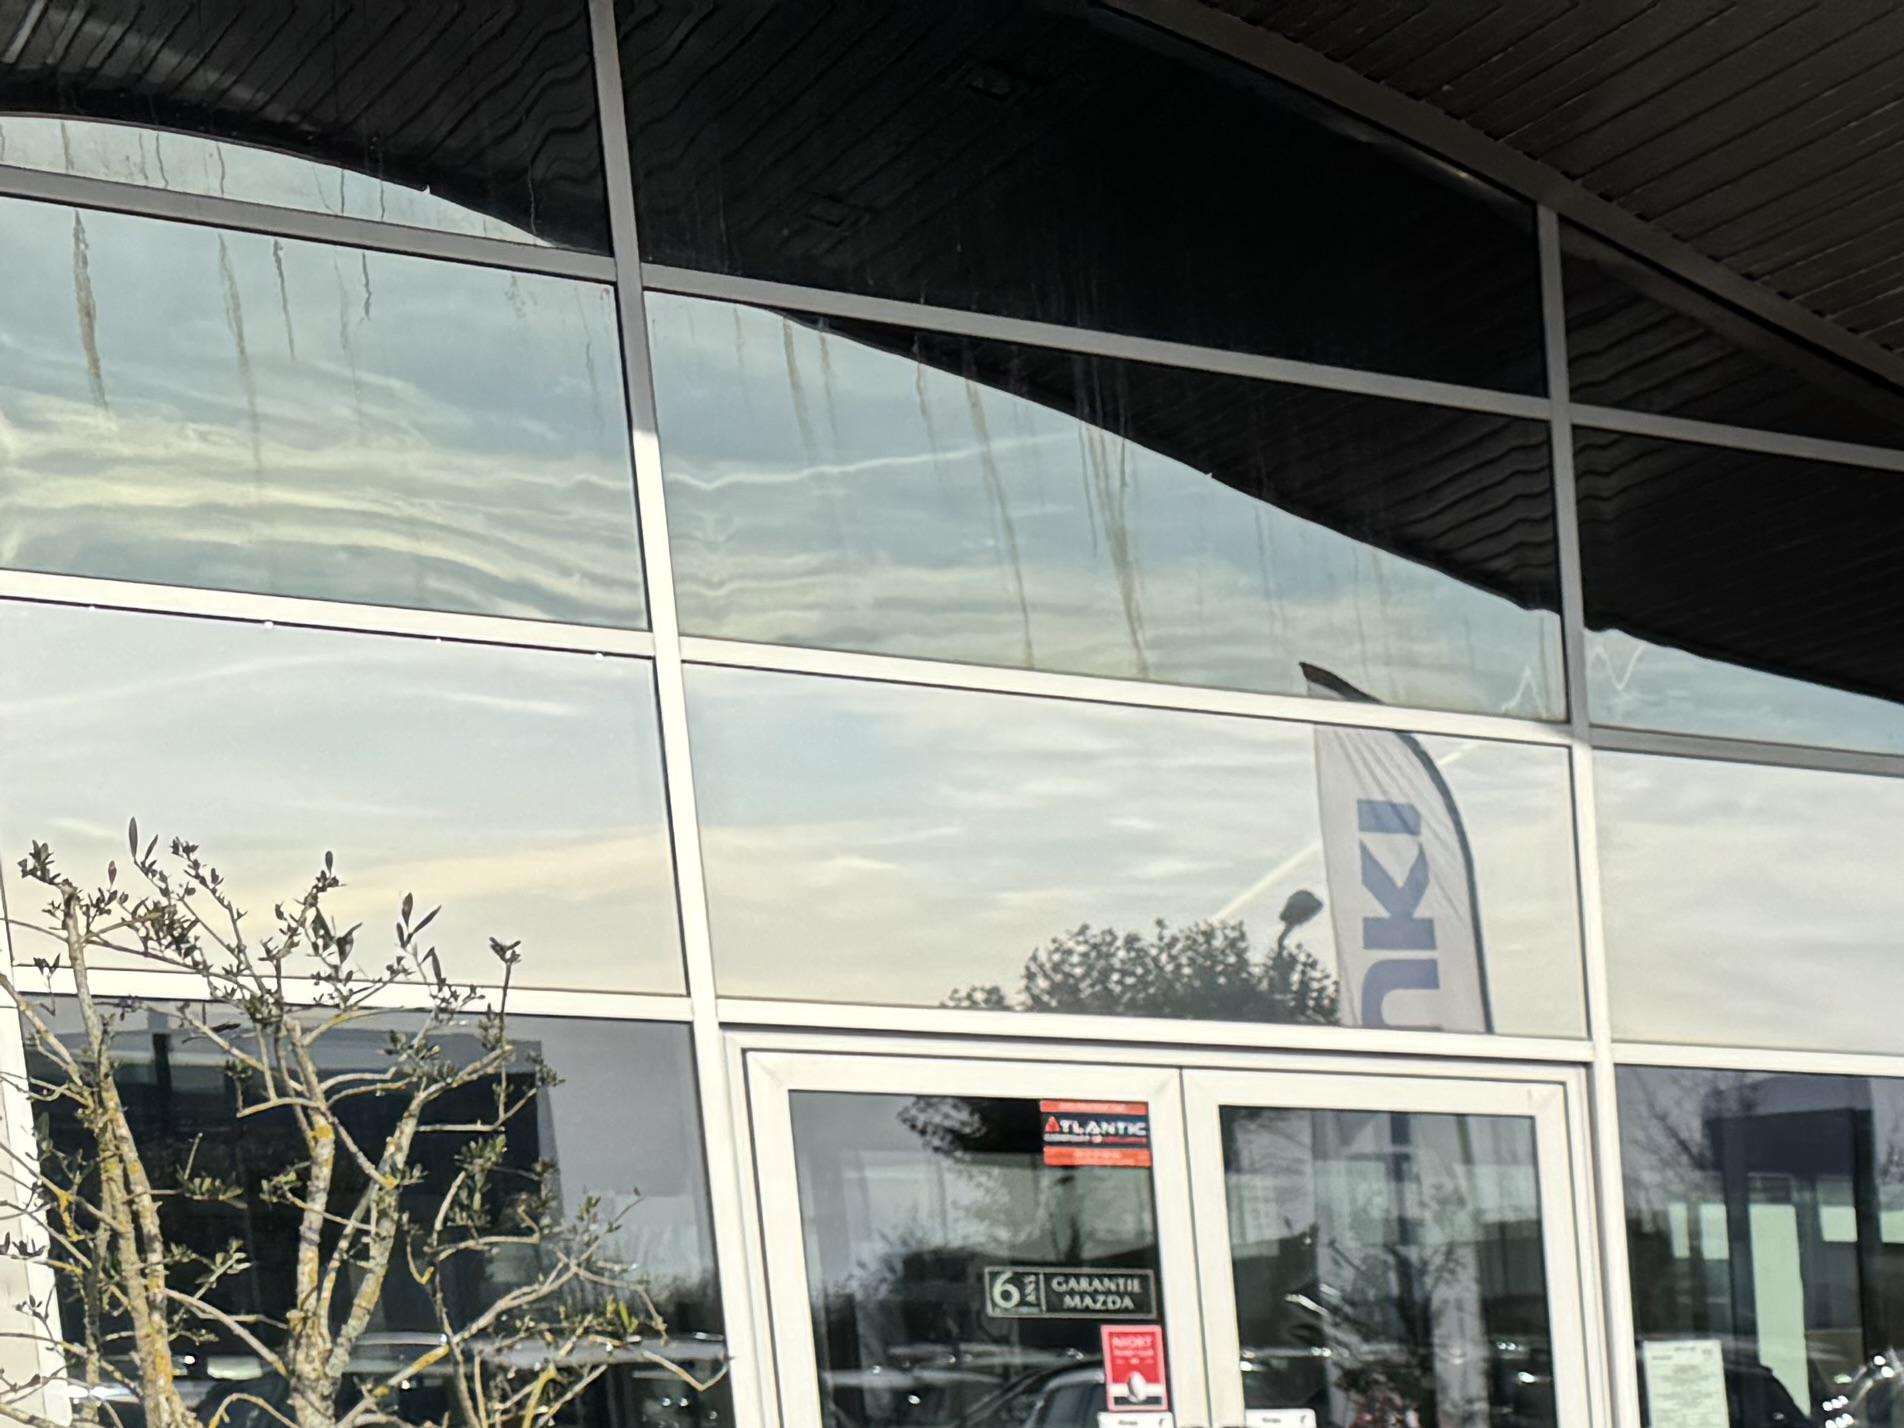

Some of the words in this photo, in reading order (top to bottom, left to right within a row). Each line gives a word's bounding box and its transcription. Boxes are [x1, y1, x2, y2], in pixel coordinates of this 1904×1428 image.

[1044, 1116, 1147, 1136] ATLANTIC
[992, 1271, 1021, 1309] 6
[1051, 1275, 1143, 1293] GARANTIE
[1063, 1294, 1135, 1310] MAZDA
